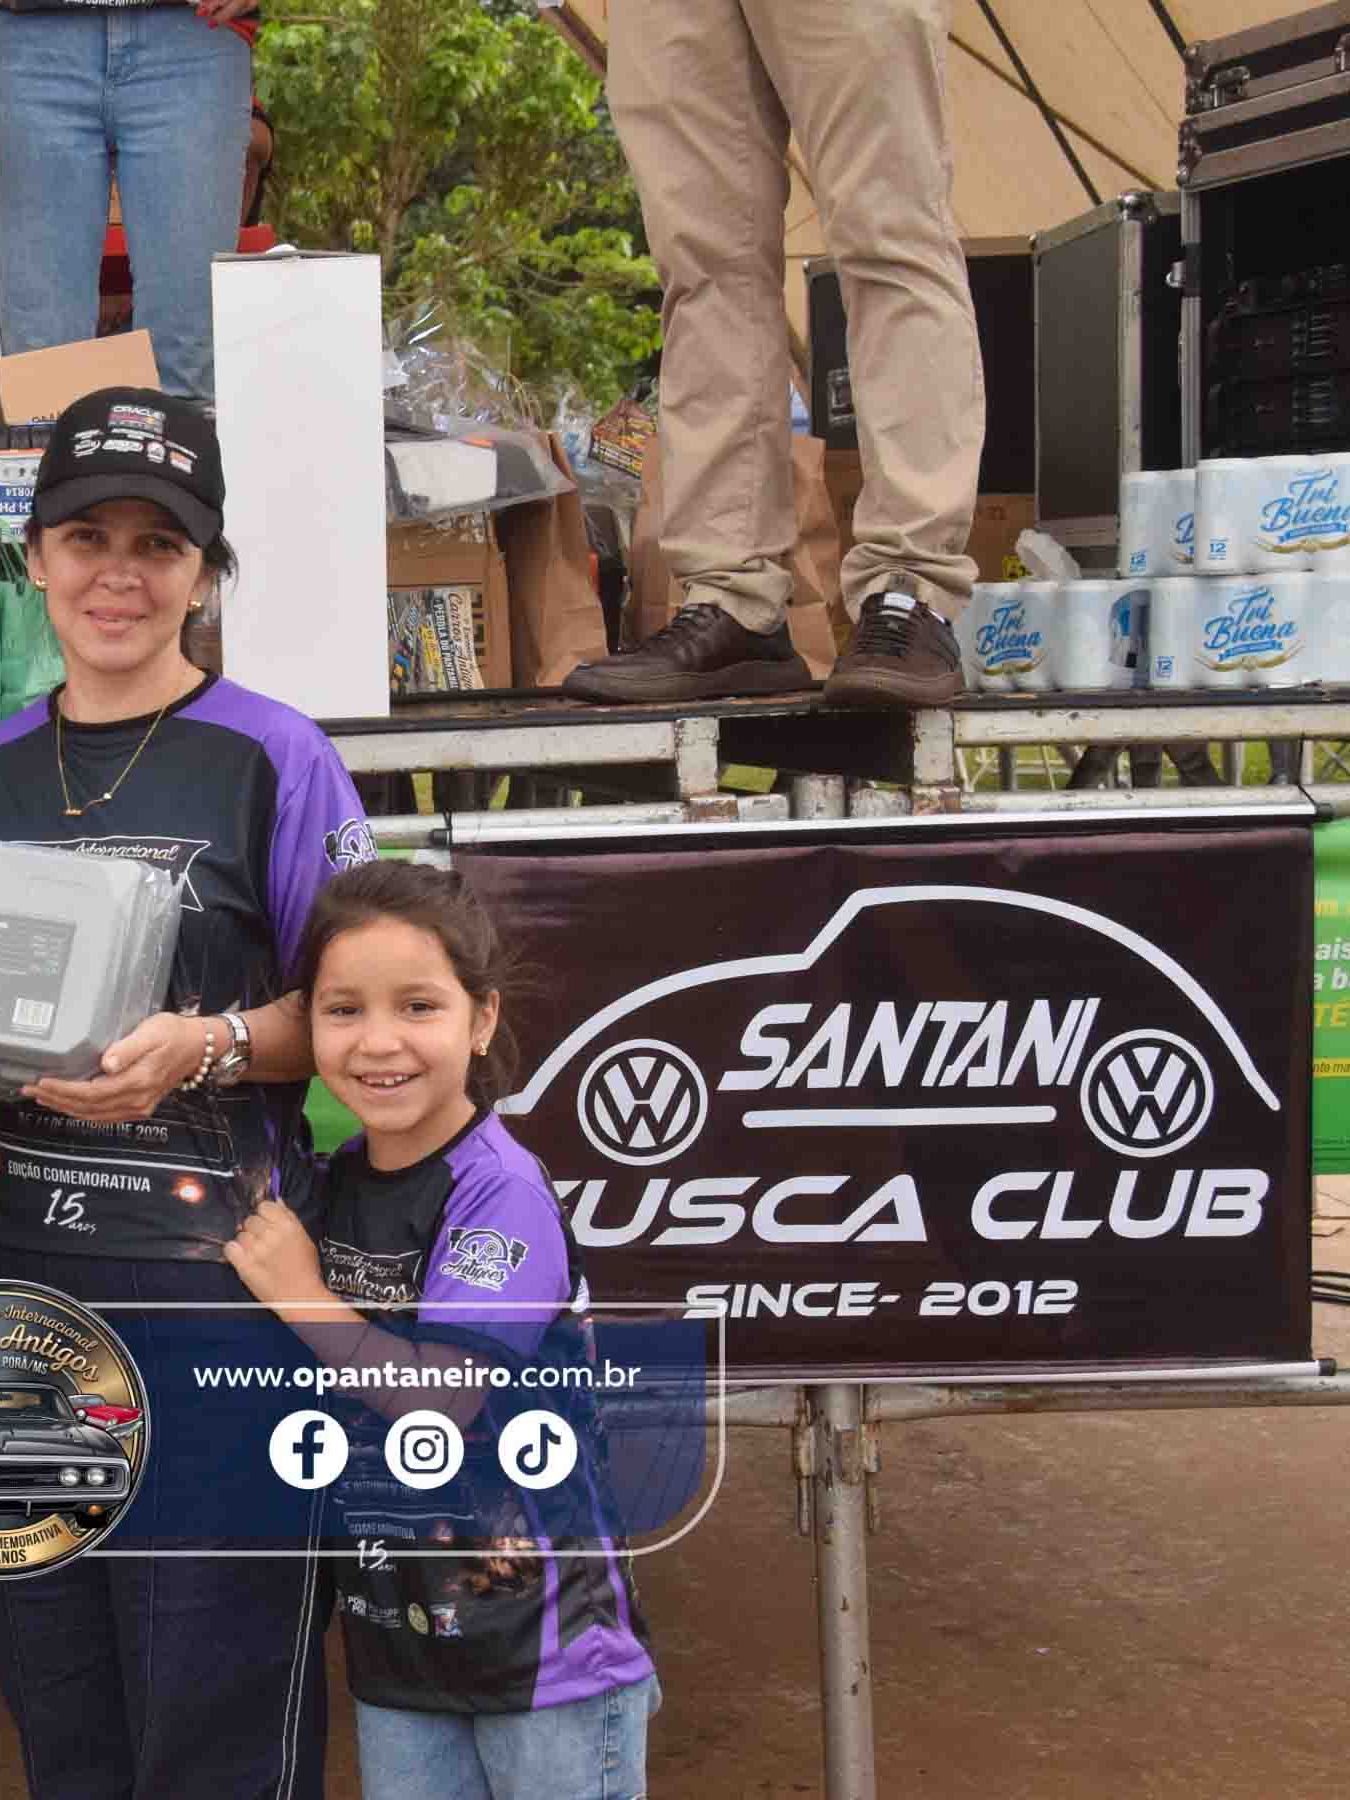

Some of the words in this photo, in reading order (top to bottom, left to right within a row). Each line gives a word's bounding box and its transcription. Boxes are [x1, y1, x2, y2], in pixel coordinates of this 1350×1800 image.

[1290, 475, 1338, 506] Tri
[1131, 552, 1146, 567] 12
[1210, 541, 1227, 556] 12
[993, 607, 1025, 632] Tri
[1228, 592, 1273, 623] Tri
[976, 626, 1042, 655] Buena
[1203, 617, 1296, 650] Buena
[1157, 659, 1173, 675] 12
[718, 997, 1101, 1092] SANTANI
[8, 1159, 41, 1180] EDIÇÃO
[43, 1167, 151, 1193] COMEMORATIVA
[43, 1188, 87, 1226] 15
[553, 1175, 928, 1247] USCA
[971, 1168, 1271, 1242] CLUB
[918, 1279, 1080, 1317] 2012
[356, 1539, 388, 1570] 15
